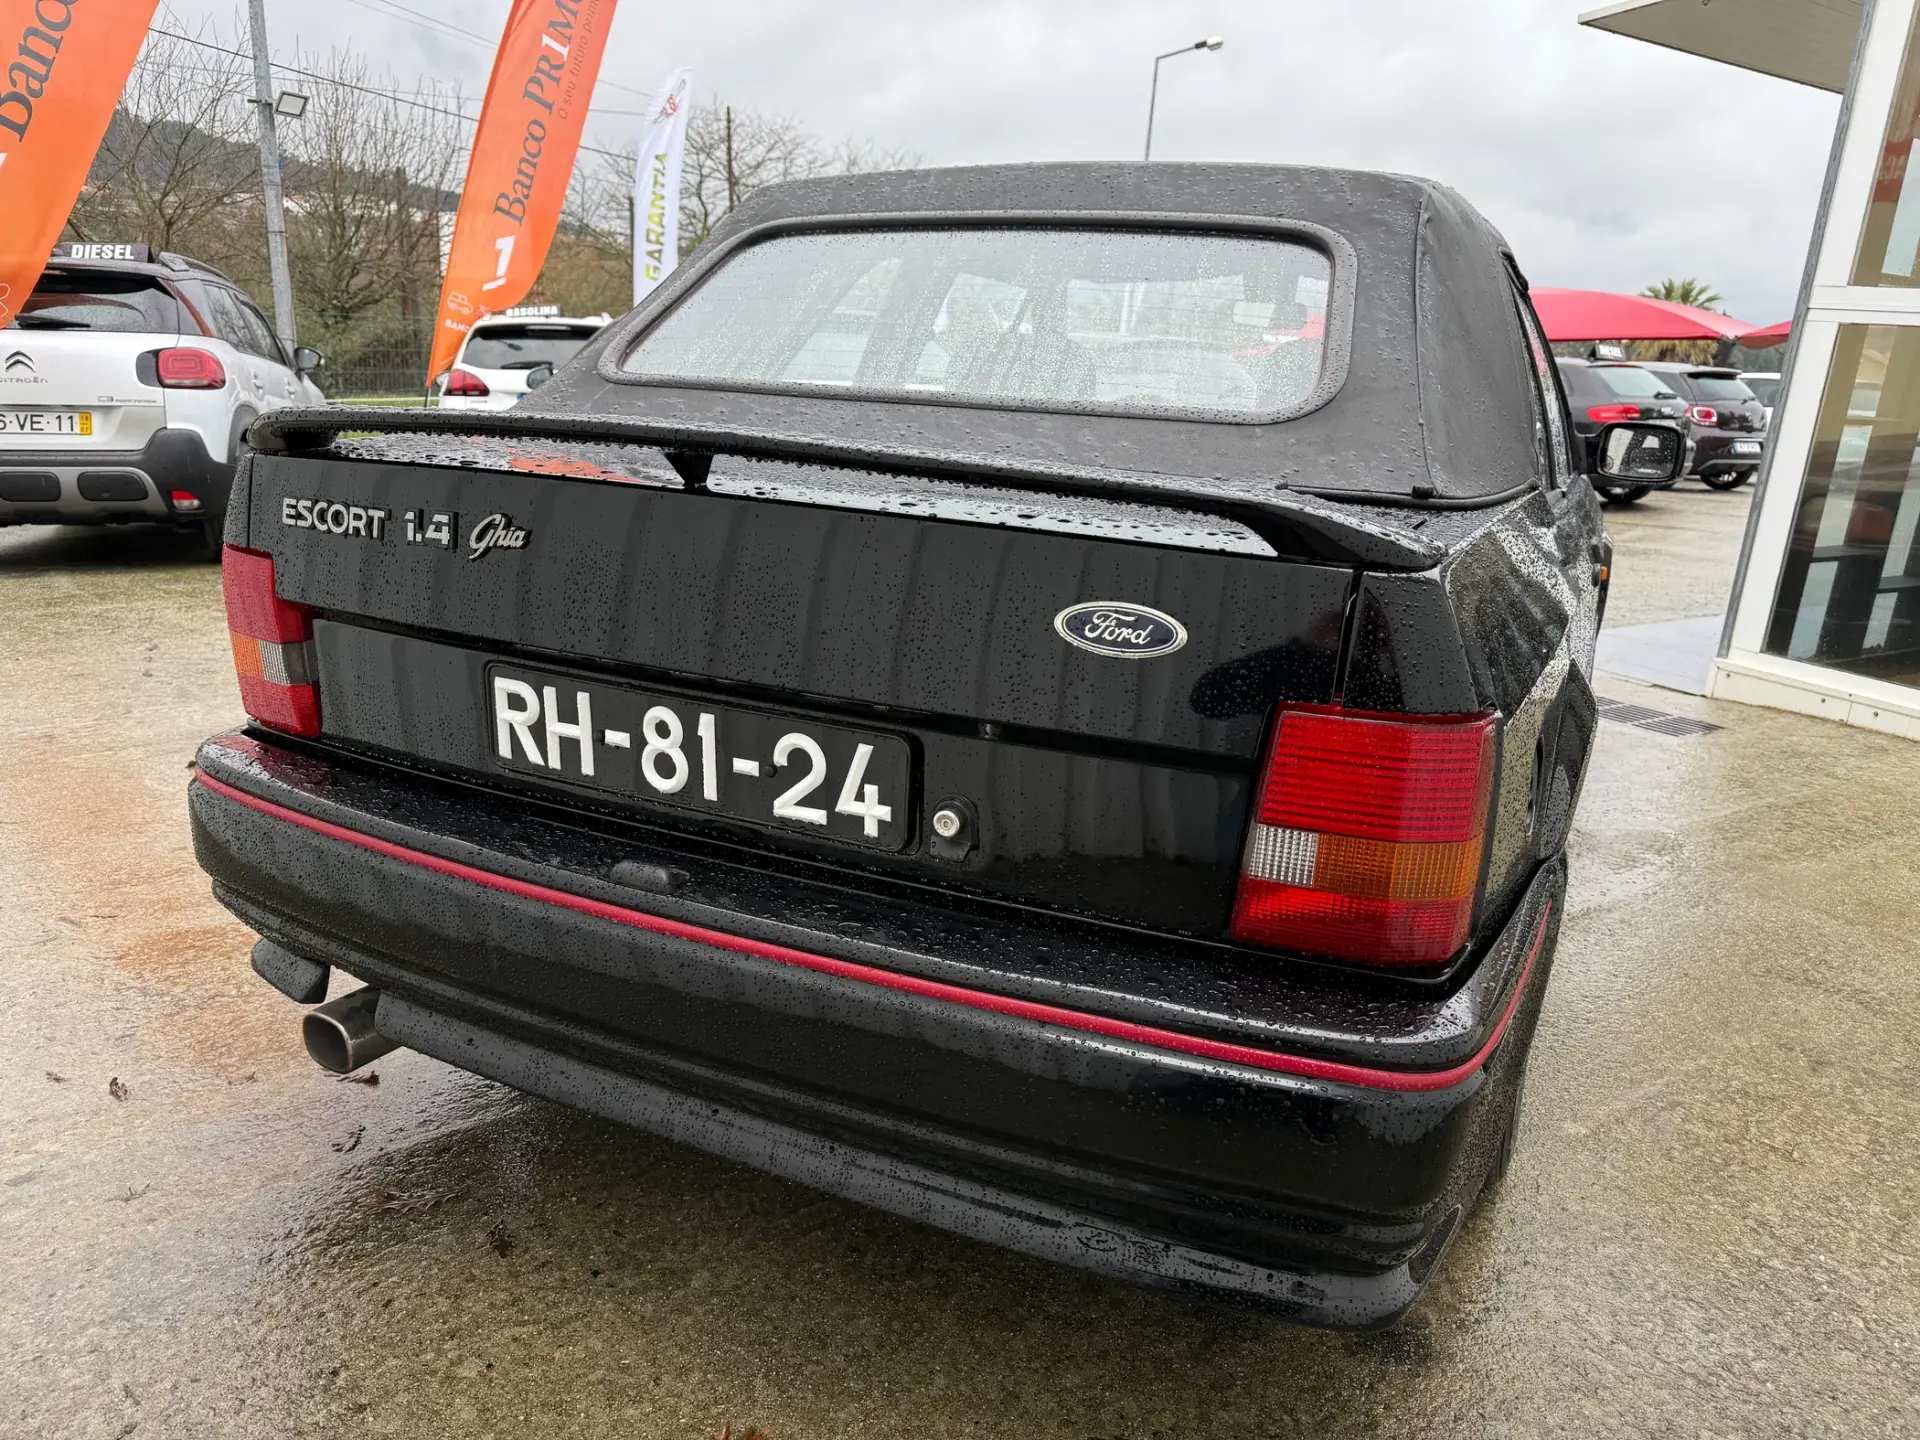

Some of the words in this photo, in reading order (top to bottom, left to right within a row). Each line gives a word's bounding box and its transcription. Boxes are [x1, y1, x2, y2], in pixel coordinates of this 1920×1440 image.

[493, 119, 547, 227] Banco
[523, 0, 582, 117] PR1M
[556, 107, 568, 120] O
[564, 81, 577, 106] seu
[645, 153, 668, 282] GARANTIA
[71, 243, 135, 260] DIESEL
[505, 304, 559, 317] GASOLINA
[281, 496, 386, 540] ESCORT
[404, 510, 450, 545] 1.4
[468, 512, 527, 560] Ghia
[1084, 611, 1154, 645] Ford
[494, 675, 892, 838] RH-81-24
